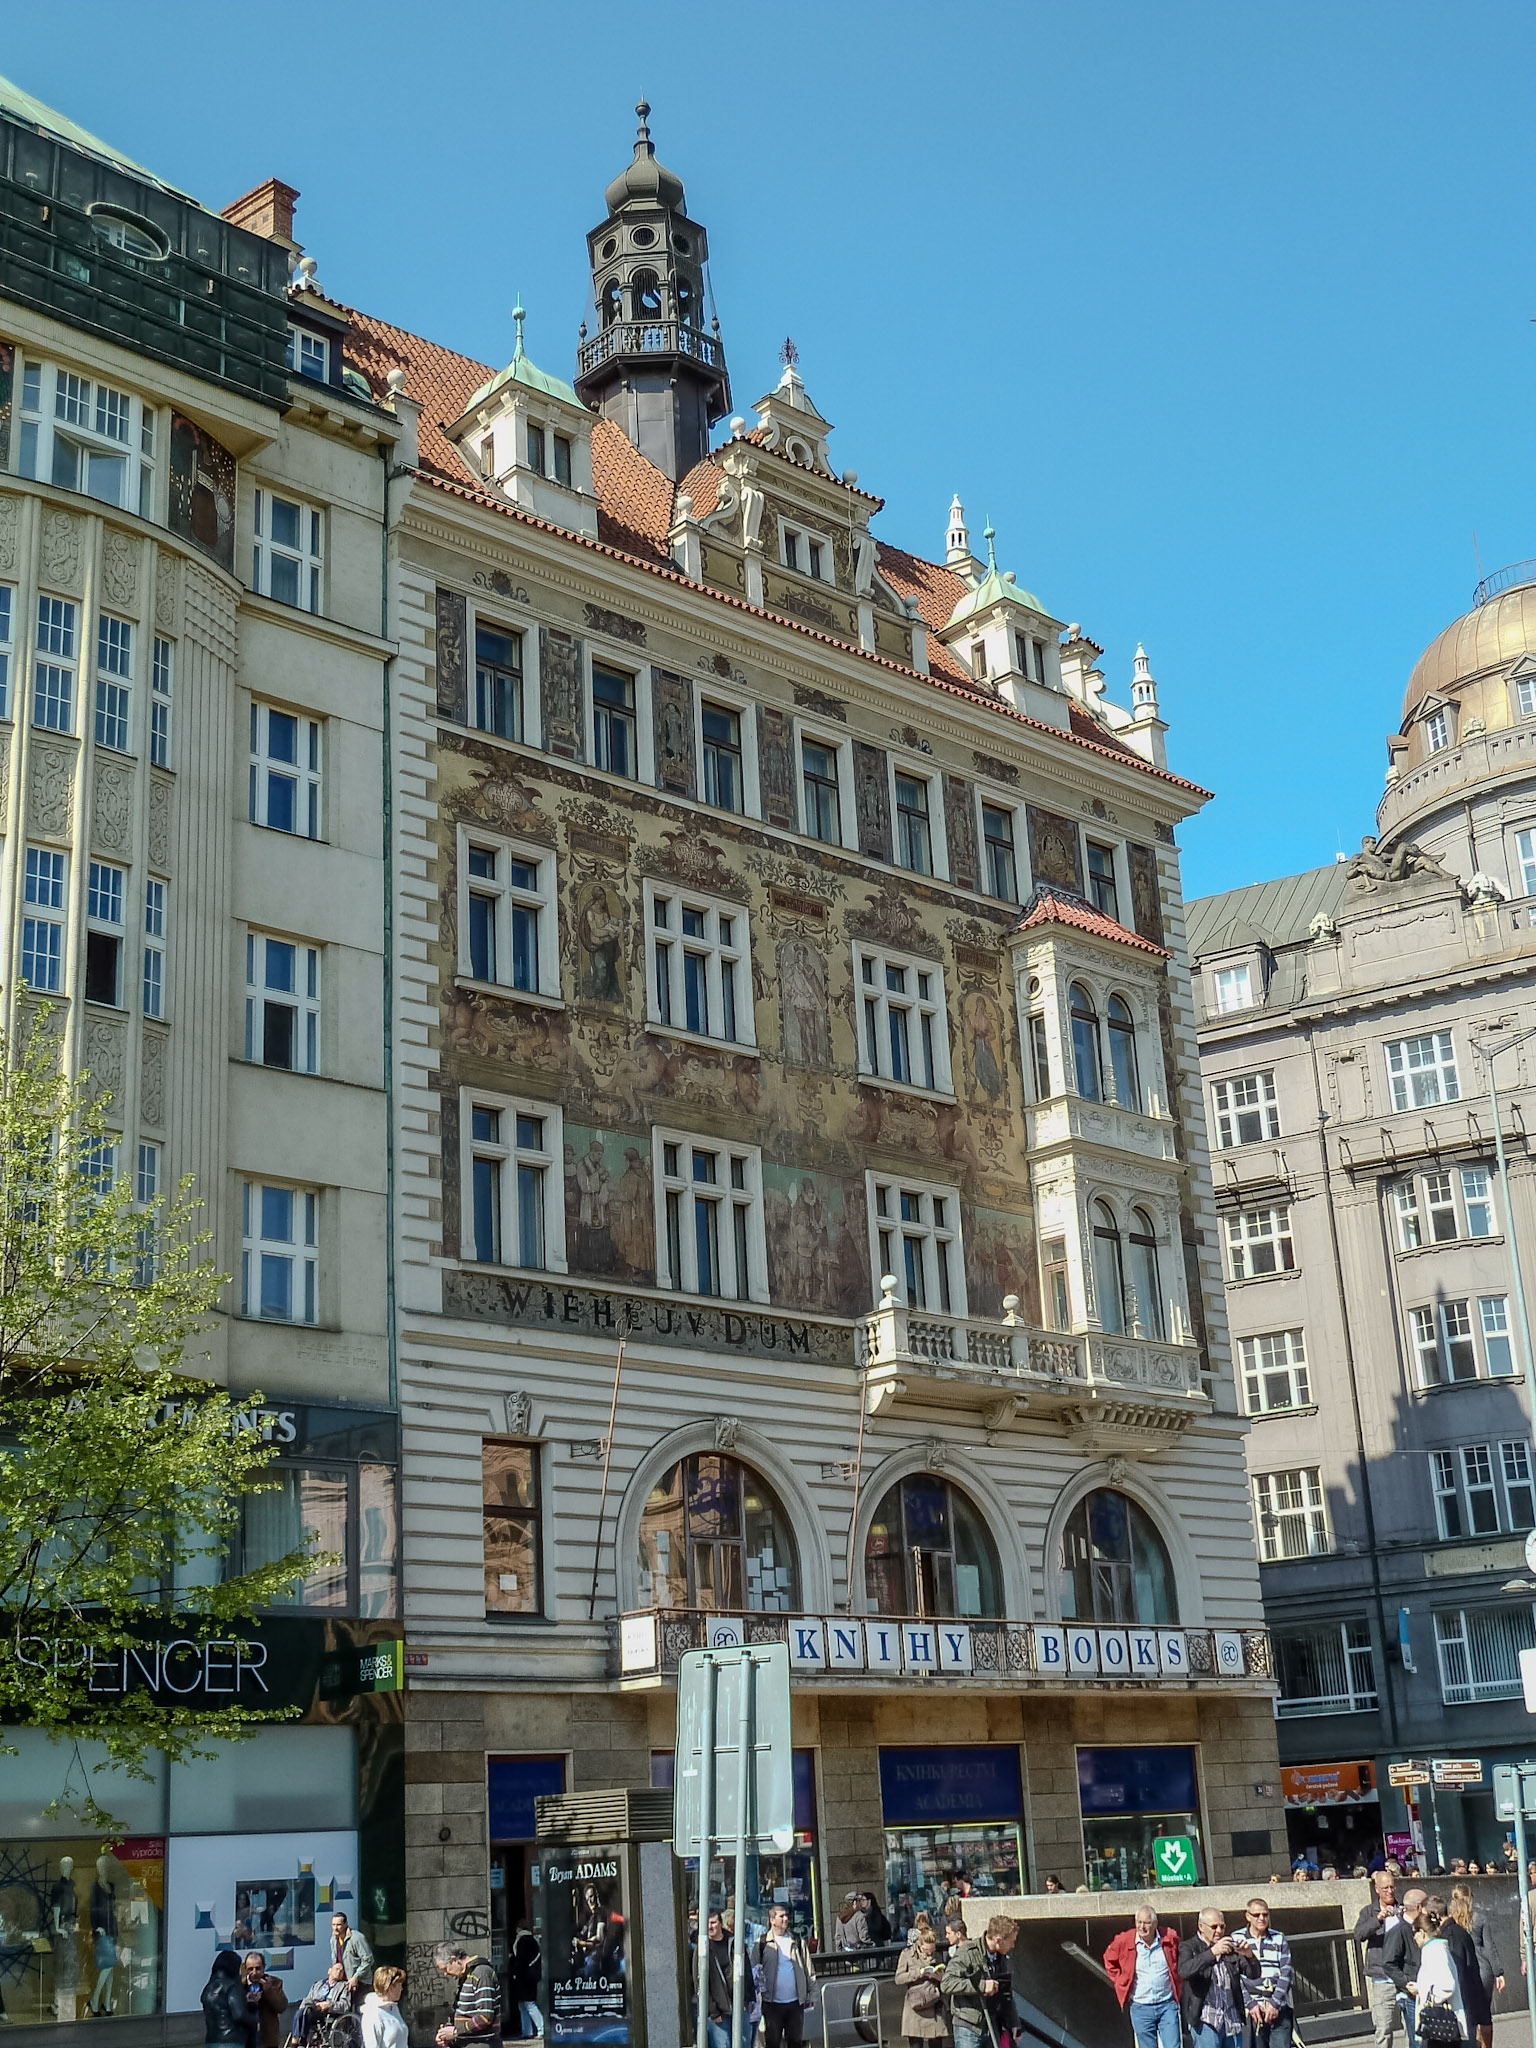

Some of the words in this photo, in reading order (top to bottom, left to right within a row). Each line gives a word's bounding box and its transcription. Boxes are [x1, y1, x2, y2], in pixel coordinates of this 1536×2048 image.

[794, 1628, 965, 1663] KNIHY
[1041, 1635, 1182, 1666] BOOKS
[17, 1635, 269, 1694] SPENCER
[360, 1666, 393, 1682] SPENCER
[549, 1866, 573, 1884] Bryan
[575, 1861, 617, 1880] ADAMS
